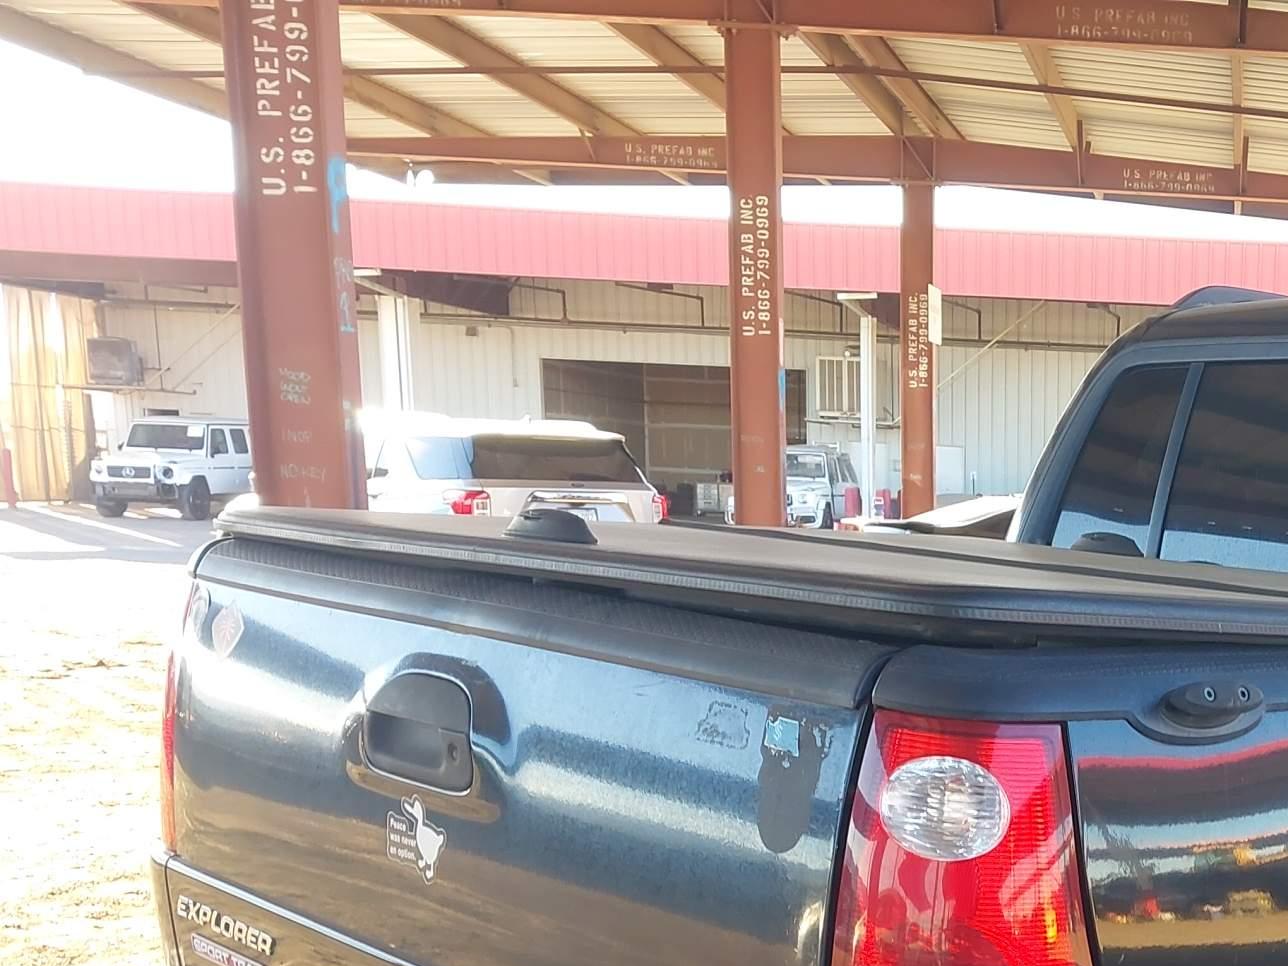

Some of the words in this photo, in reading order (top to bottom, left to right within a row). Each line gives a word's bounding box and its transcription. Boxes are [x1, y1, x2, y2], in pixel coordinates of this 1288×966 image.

[1094, 8, 1156, 25] PREFAB
[283, 0, 318, 193] 1-866-799-
[261, 137, 287, 196] U.S.
[650, 144, 693, 156] PREFAB
[741, 232, 755, 297] PREFAB
[756, 195, 772, 335] 1-866-799-0969
[742, 305, 756, 336] U.S.
[909, 318, 918, 361] PREFAB
[919, 293, 929, 387] 1-866-799-0969
[389, 817, 407, 832] Peace
[176, 894, 275, 956] EXPLORER
[193, 937, 230, 966] SPORT
